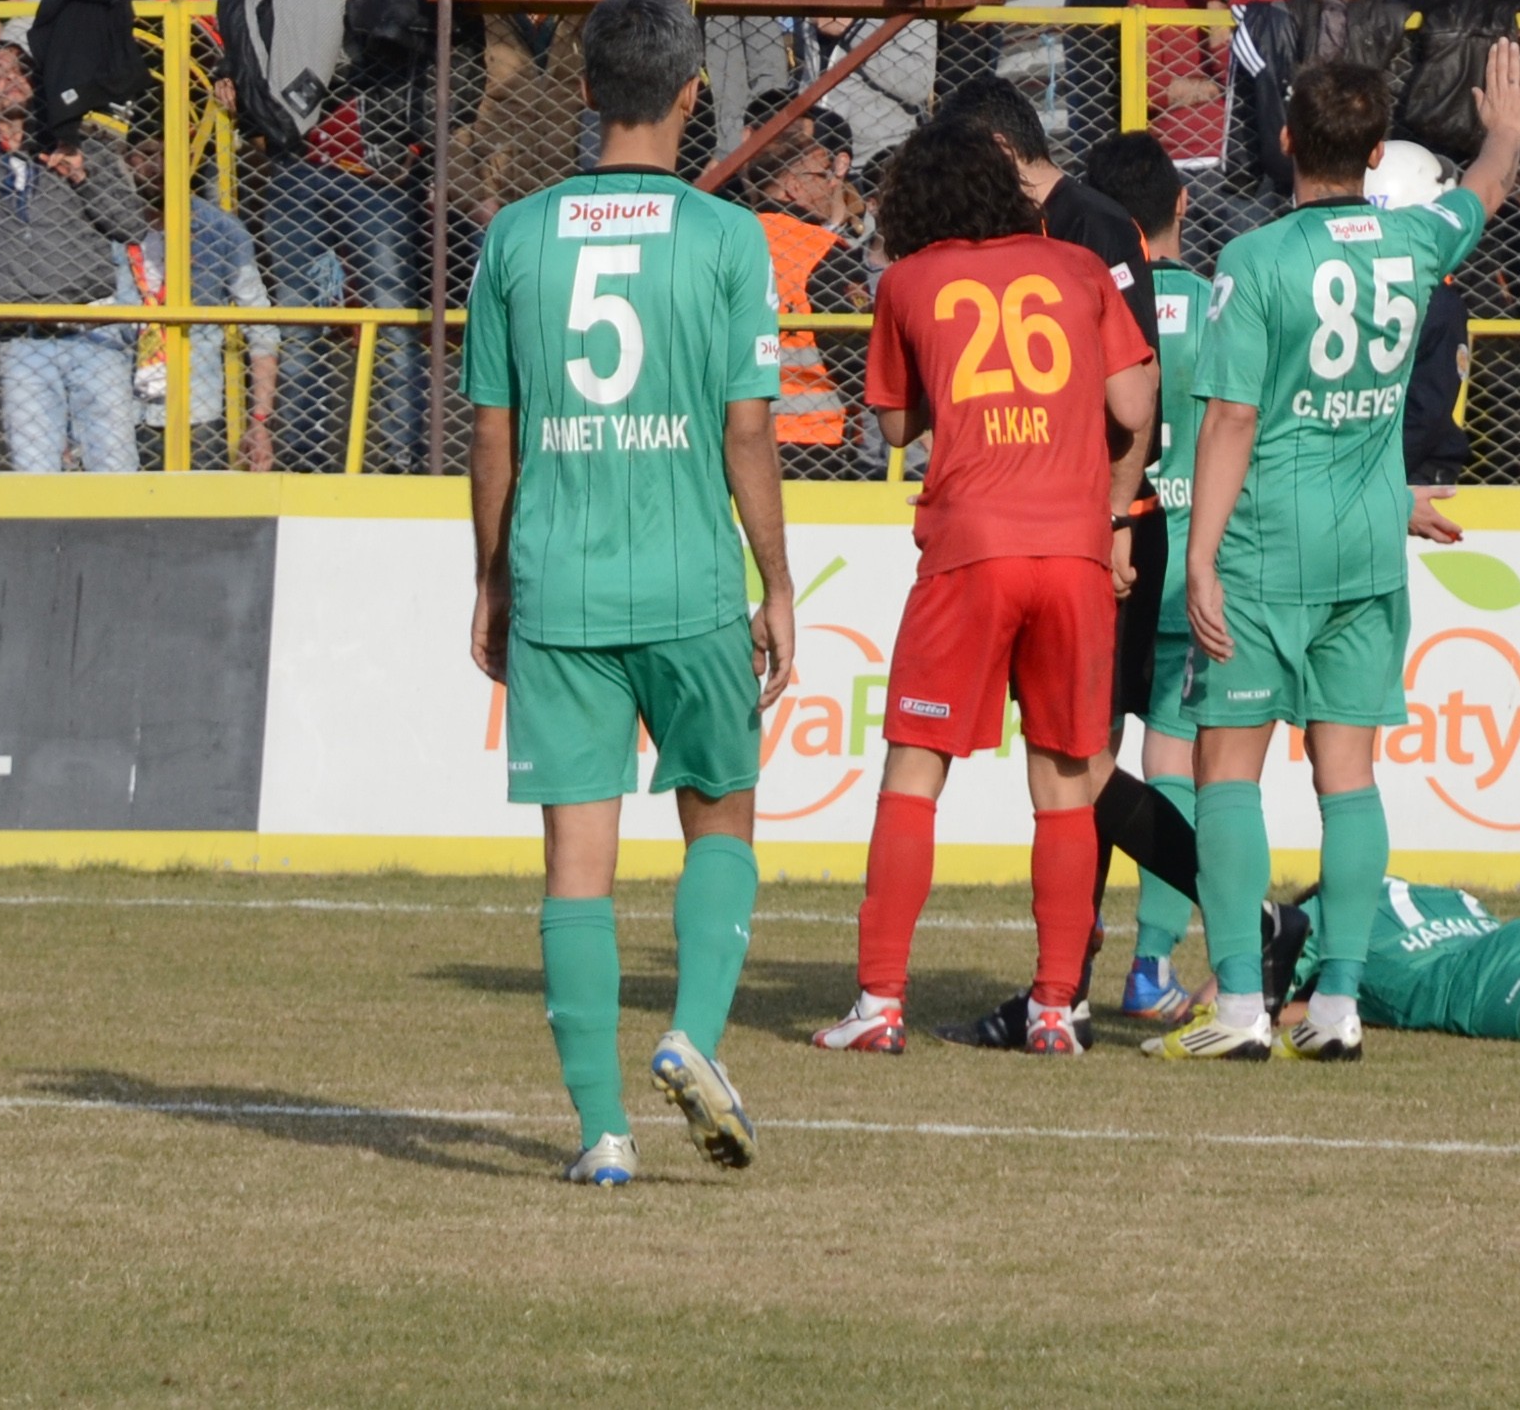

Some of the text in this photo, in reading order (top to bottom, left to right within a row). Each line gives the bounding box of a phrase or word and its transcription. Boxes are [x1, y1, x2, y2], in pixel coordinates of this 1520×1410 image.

[566, 244, 644, 405] 5
[934, 274, 1073, 404] 26
[1309, 255, 1417, 380] 85
[610, 414, 690, 451] YAKAK
